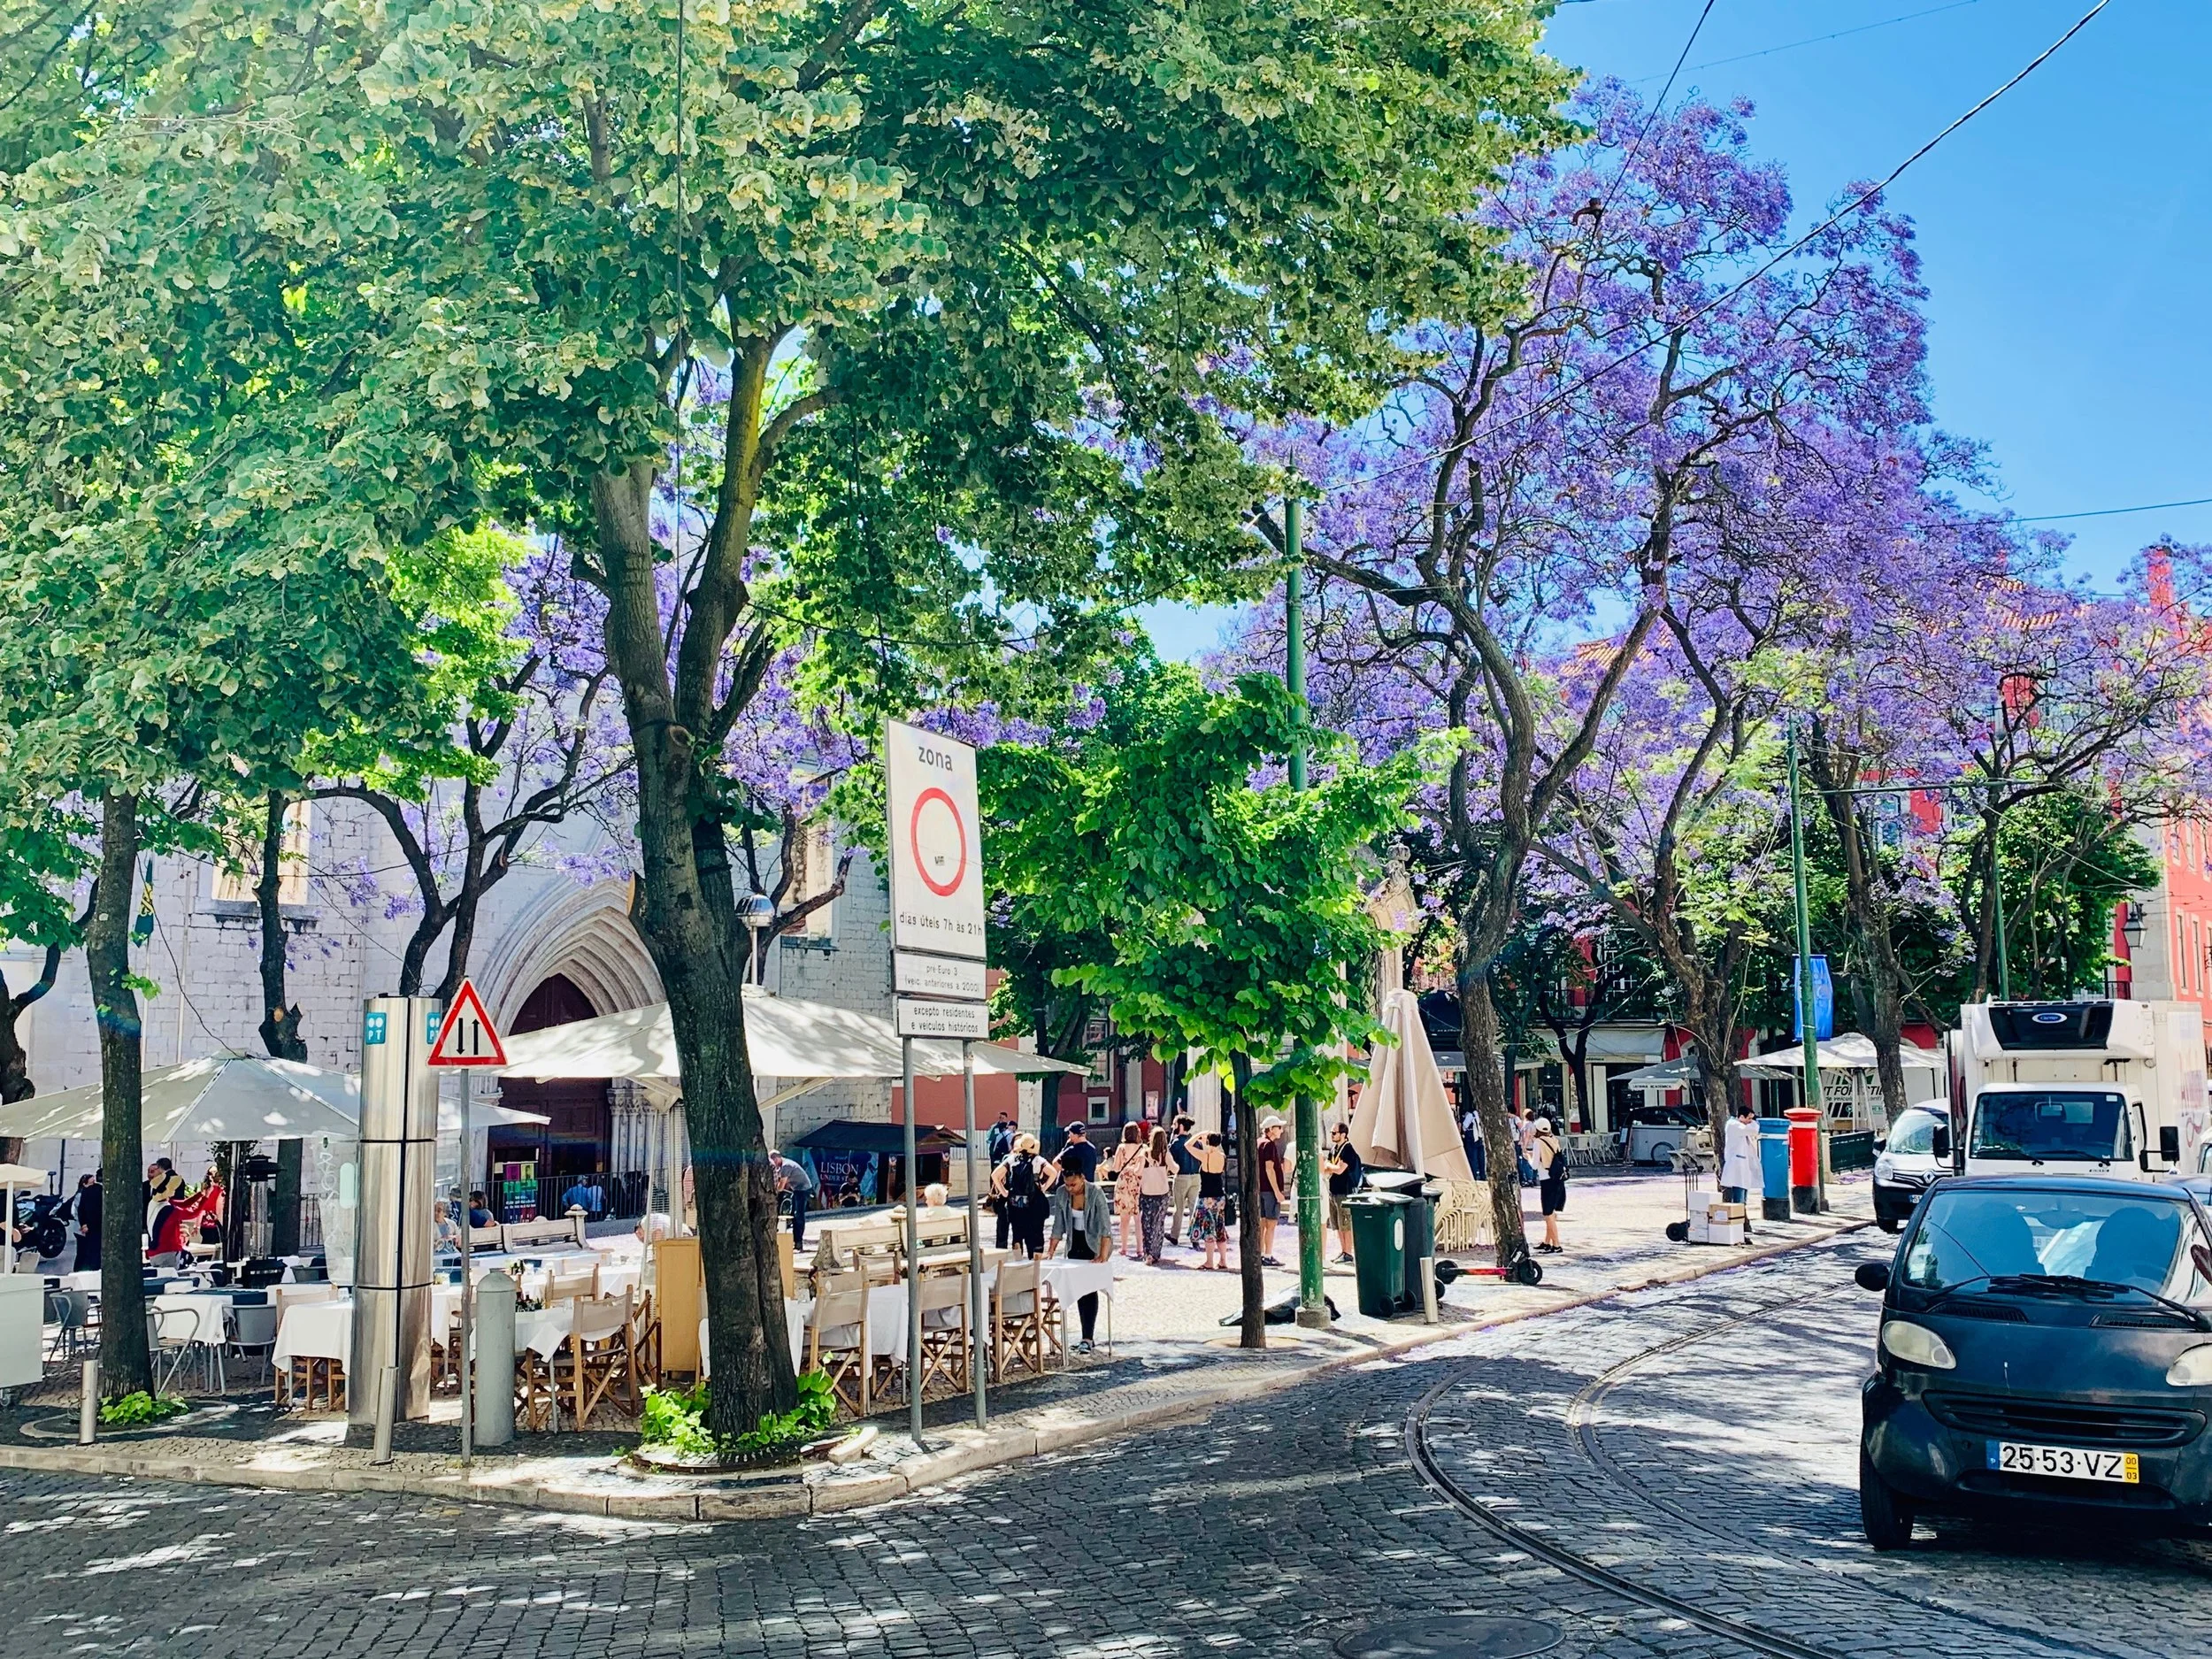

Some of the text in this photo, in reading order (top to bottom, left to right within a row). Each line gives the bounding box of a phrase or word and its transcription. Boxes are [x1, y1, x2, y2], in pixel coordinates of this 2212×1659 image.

[918, 746, 953, 772] zona
[900, 911, 917, 926] dias
[920, 915, 940, 930] úteis
[943, 918, 953, 931] 7h
[968, 923, 982, 936] 21h
[954, 967, 958, 976] 3
[914, 1006, 975, 1018] excepto residentes
[911, 1021, 916, 1030] e
[368, 1029, 382, 1041] PT
[820, 1162, 859, 1175] LISBON
